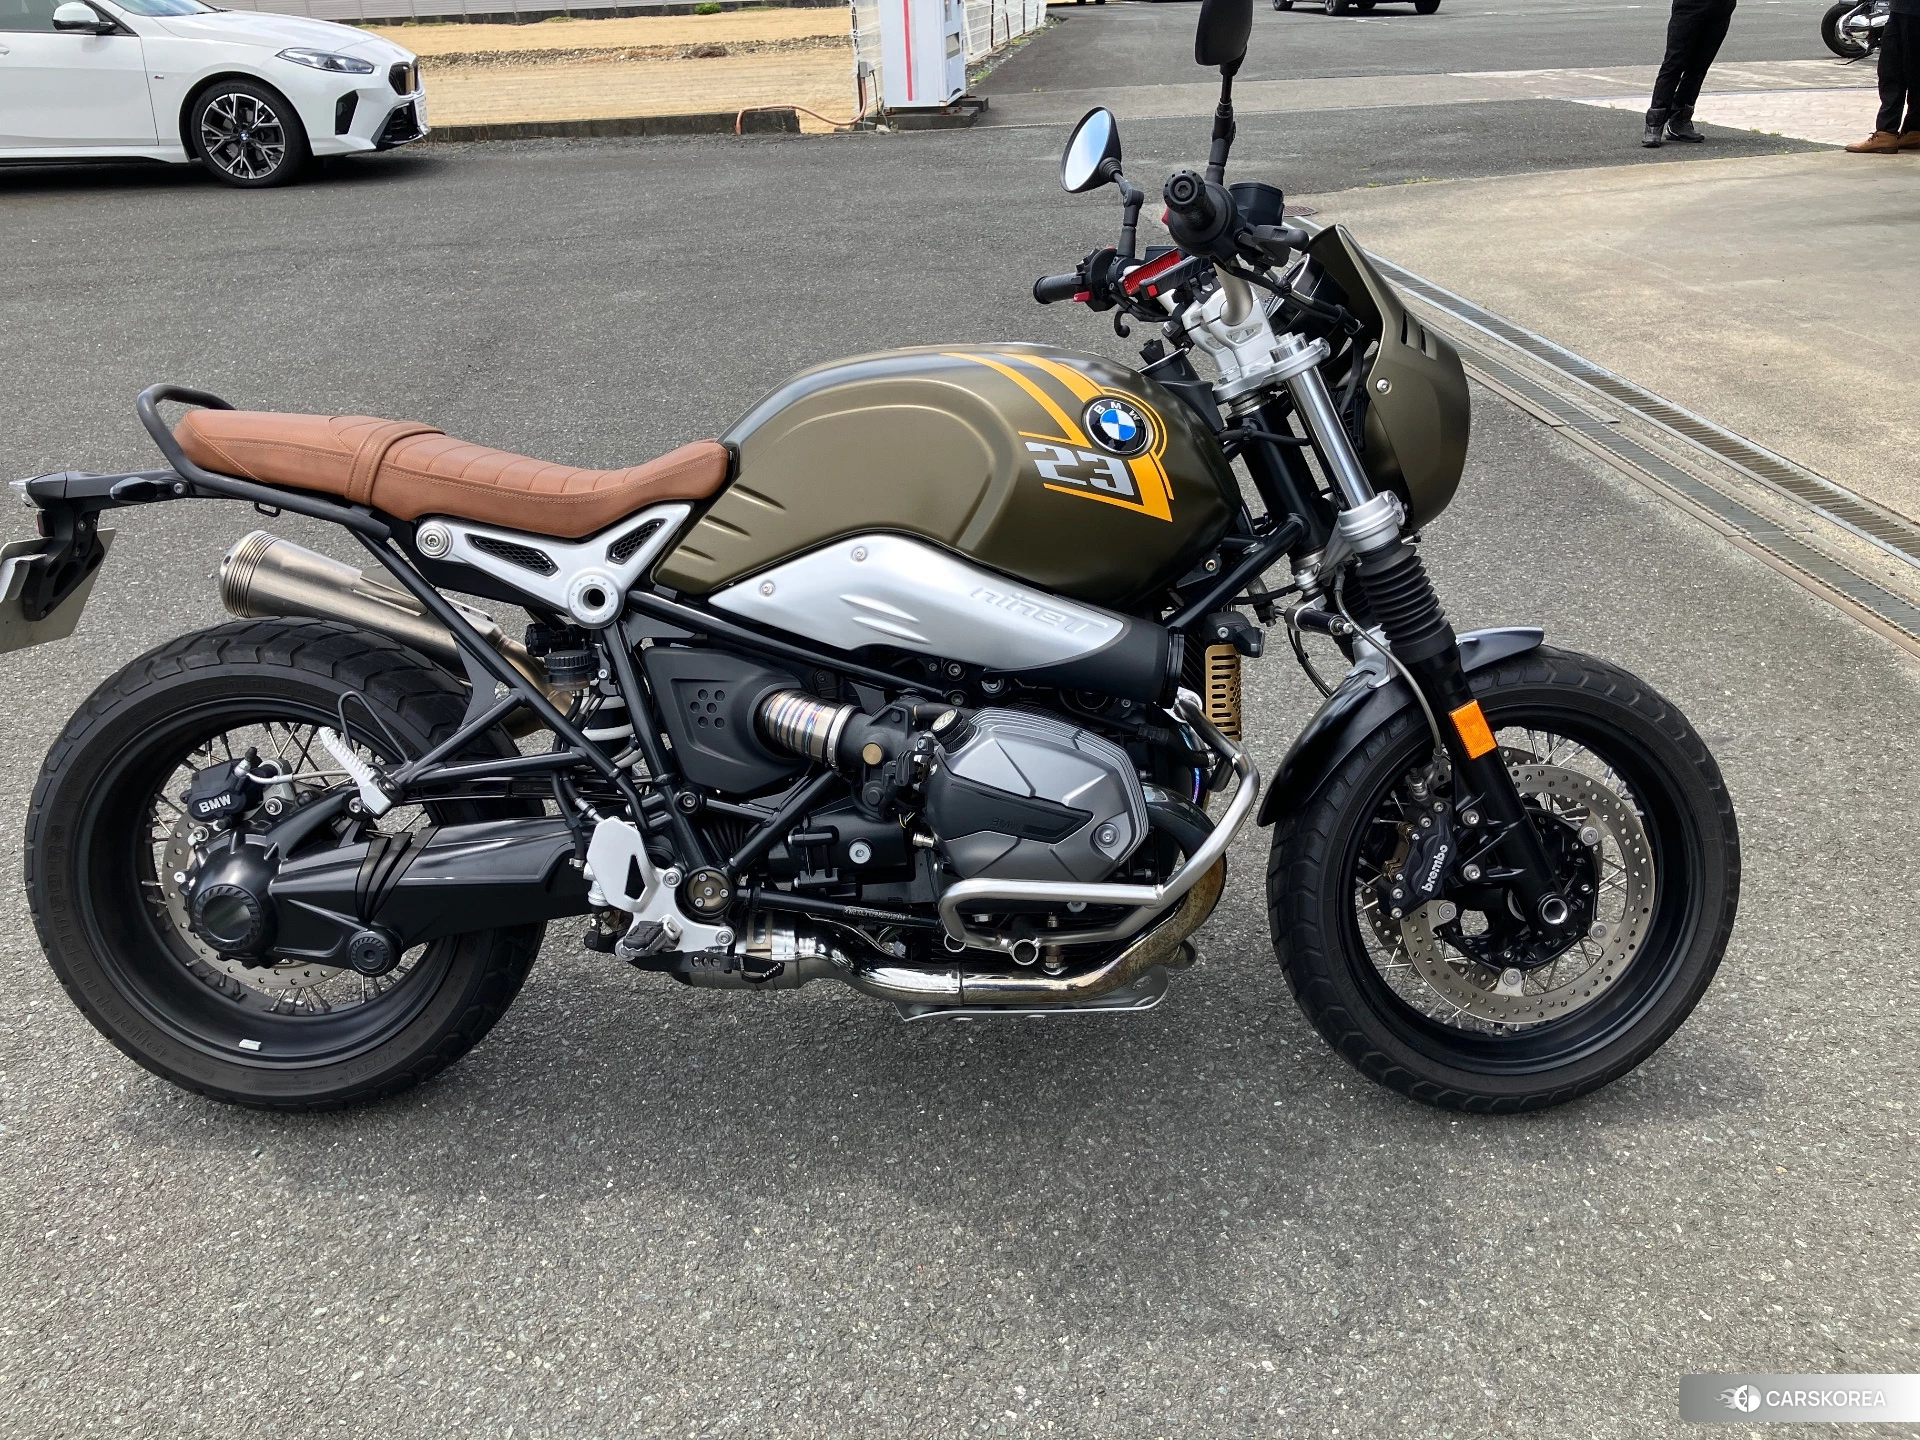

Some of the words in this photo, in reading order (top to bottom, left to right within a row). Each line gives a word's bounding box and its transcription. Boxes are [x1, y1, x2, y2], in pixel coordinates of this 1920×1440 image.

[1093, 401, 1141, 421] BMW
[1025, 441, 1135, 496] 23
[970, 586, 1108, 633] nineT
[198, 794, 231, 813] BMW
[1421, 844, 1448, 892] brembo
